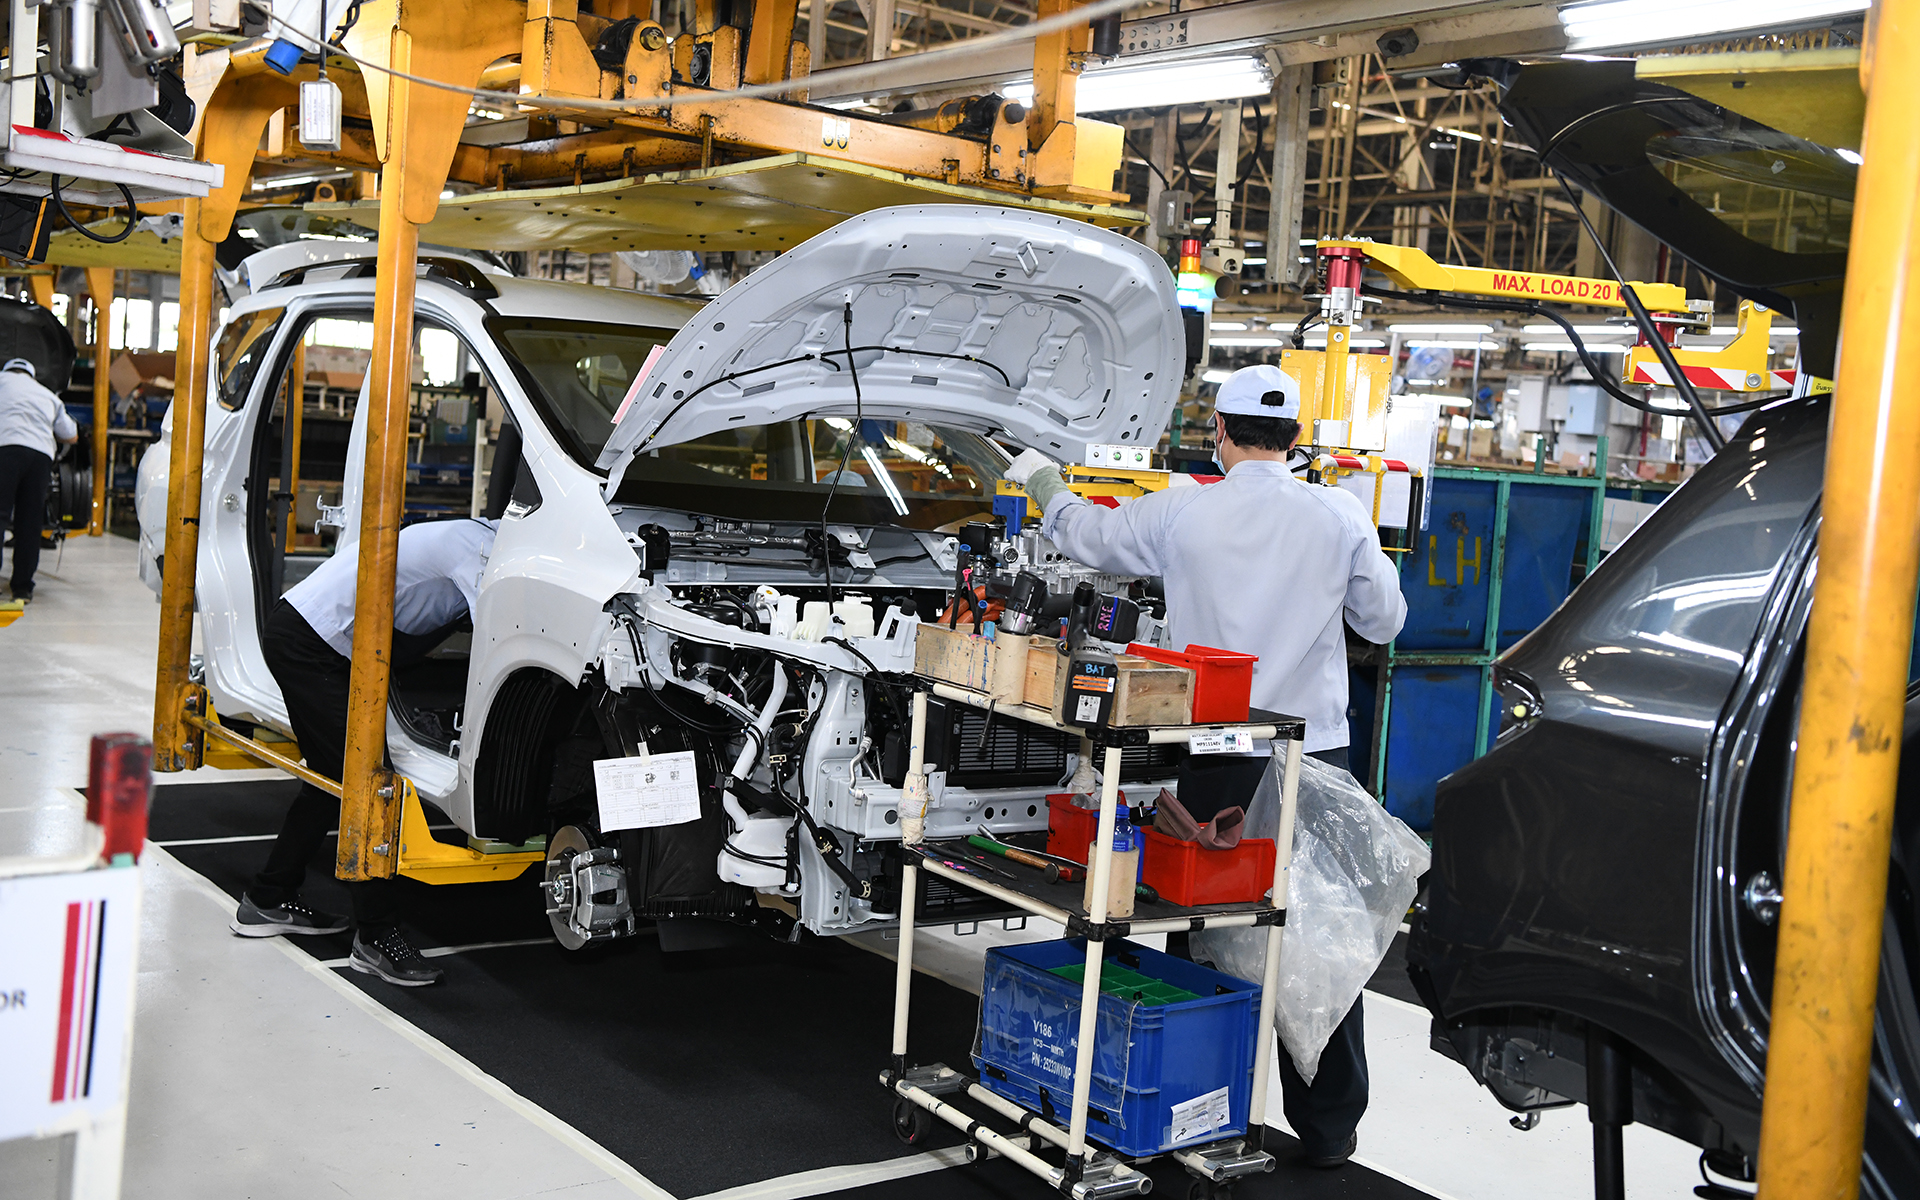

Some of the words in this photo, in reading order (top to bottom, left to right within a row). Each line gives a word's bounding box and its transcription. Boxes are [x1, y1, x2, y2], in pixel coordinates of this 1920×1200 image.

[1493, 274, 1534, 293] MAX.
[1541, 278, 1590, 297] LOAD
[1593, 283, 1611, 300] 20
[1428, 534, 1482, 586] LH
[1085, 663, 1106, 676] BAT
[1033, 1020, 1052, 1038] V186
